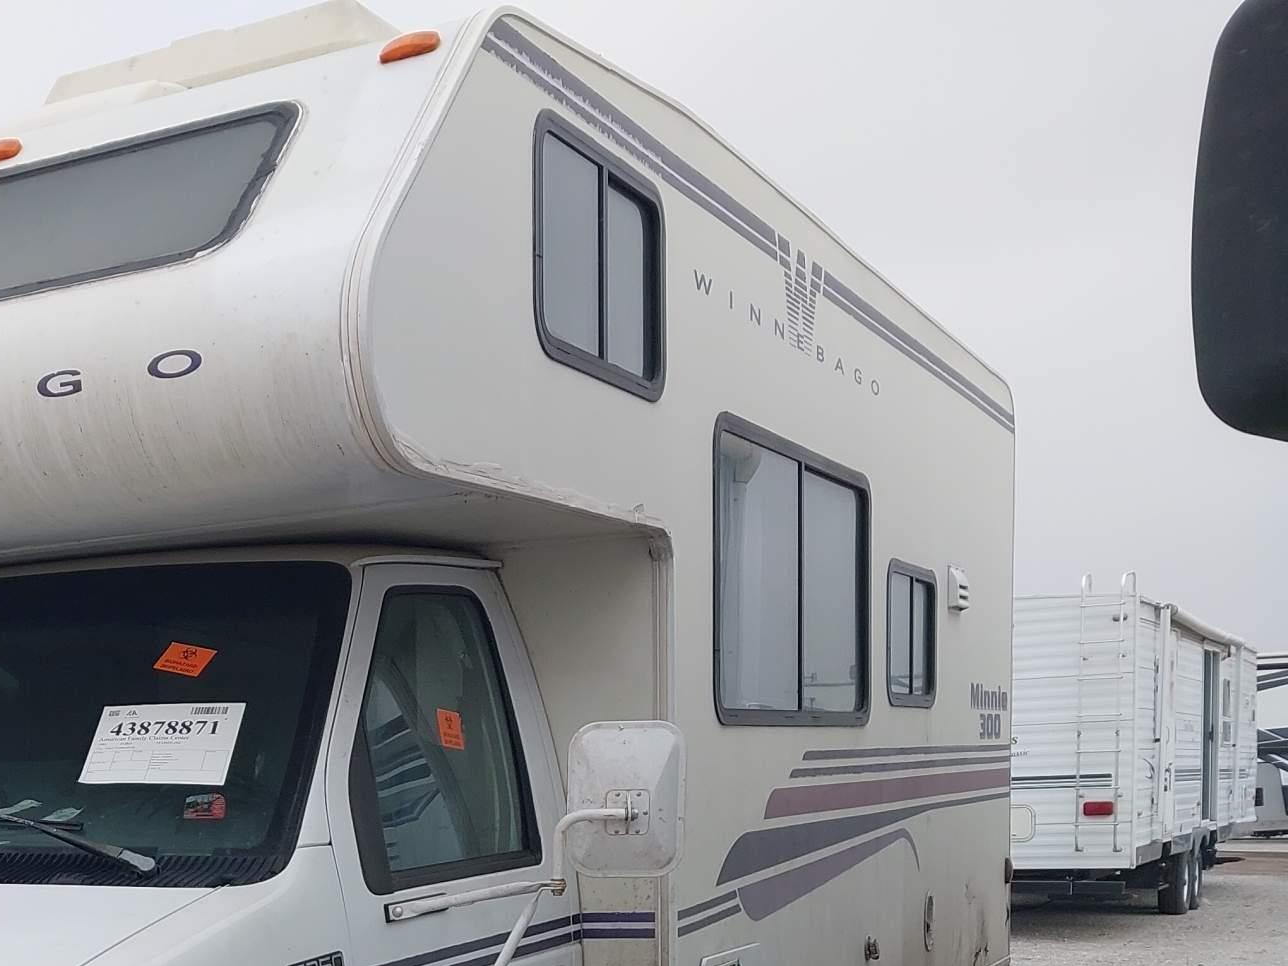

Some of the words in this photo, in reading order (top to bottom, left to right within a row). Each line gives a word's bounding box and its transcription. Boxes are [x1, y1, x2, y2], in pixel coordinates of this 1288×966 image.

[694, 269, 880, 396] WINNEBAGO
[970, 683, 1008, 711] Minnie
[109, 720, 220, 736] 43878871
[979, 713, 1001, 740] 300
